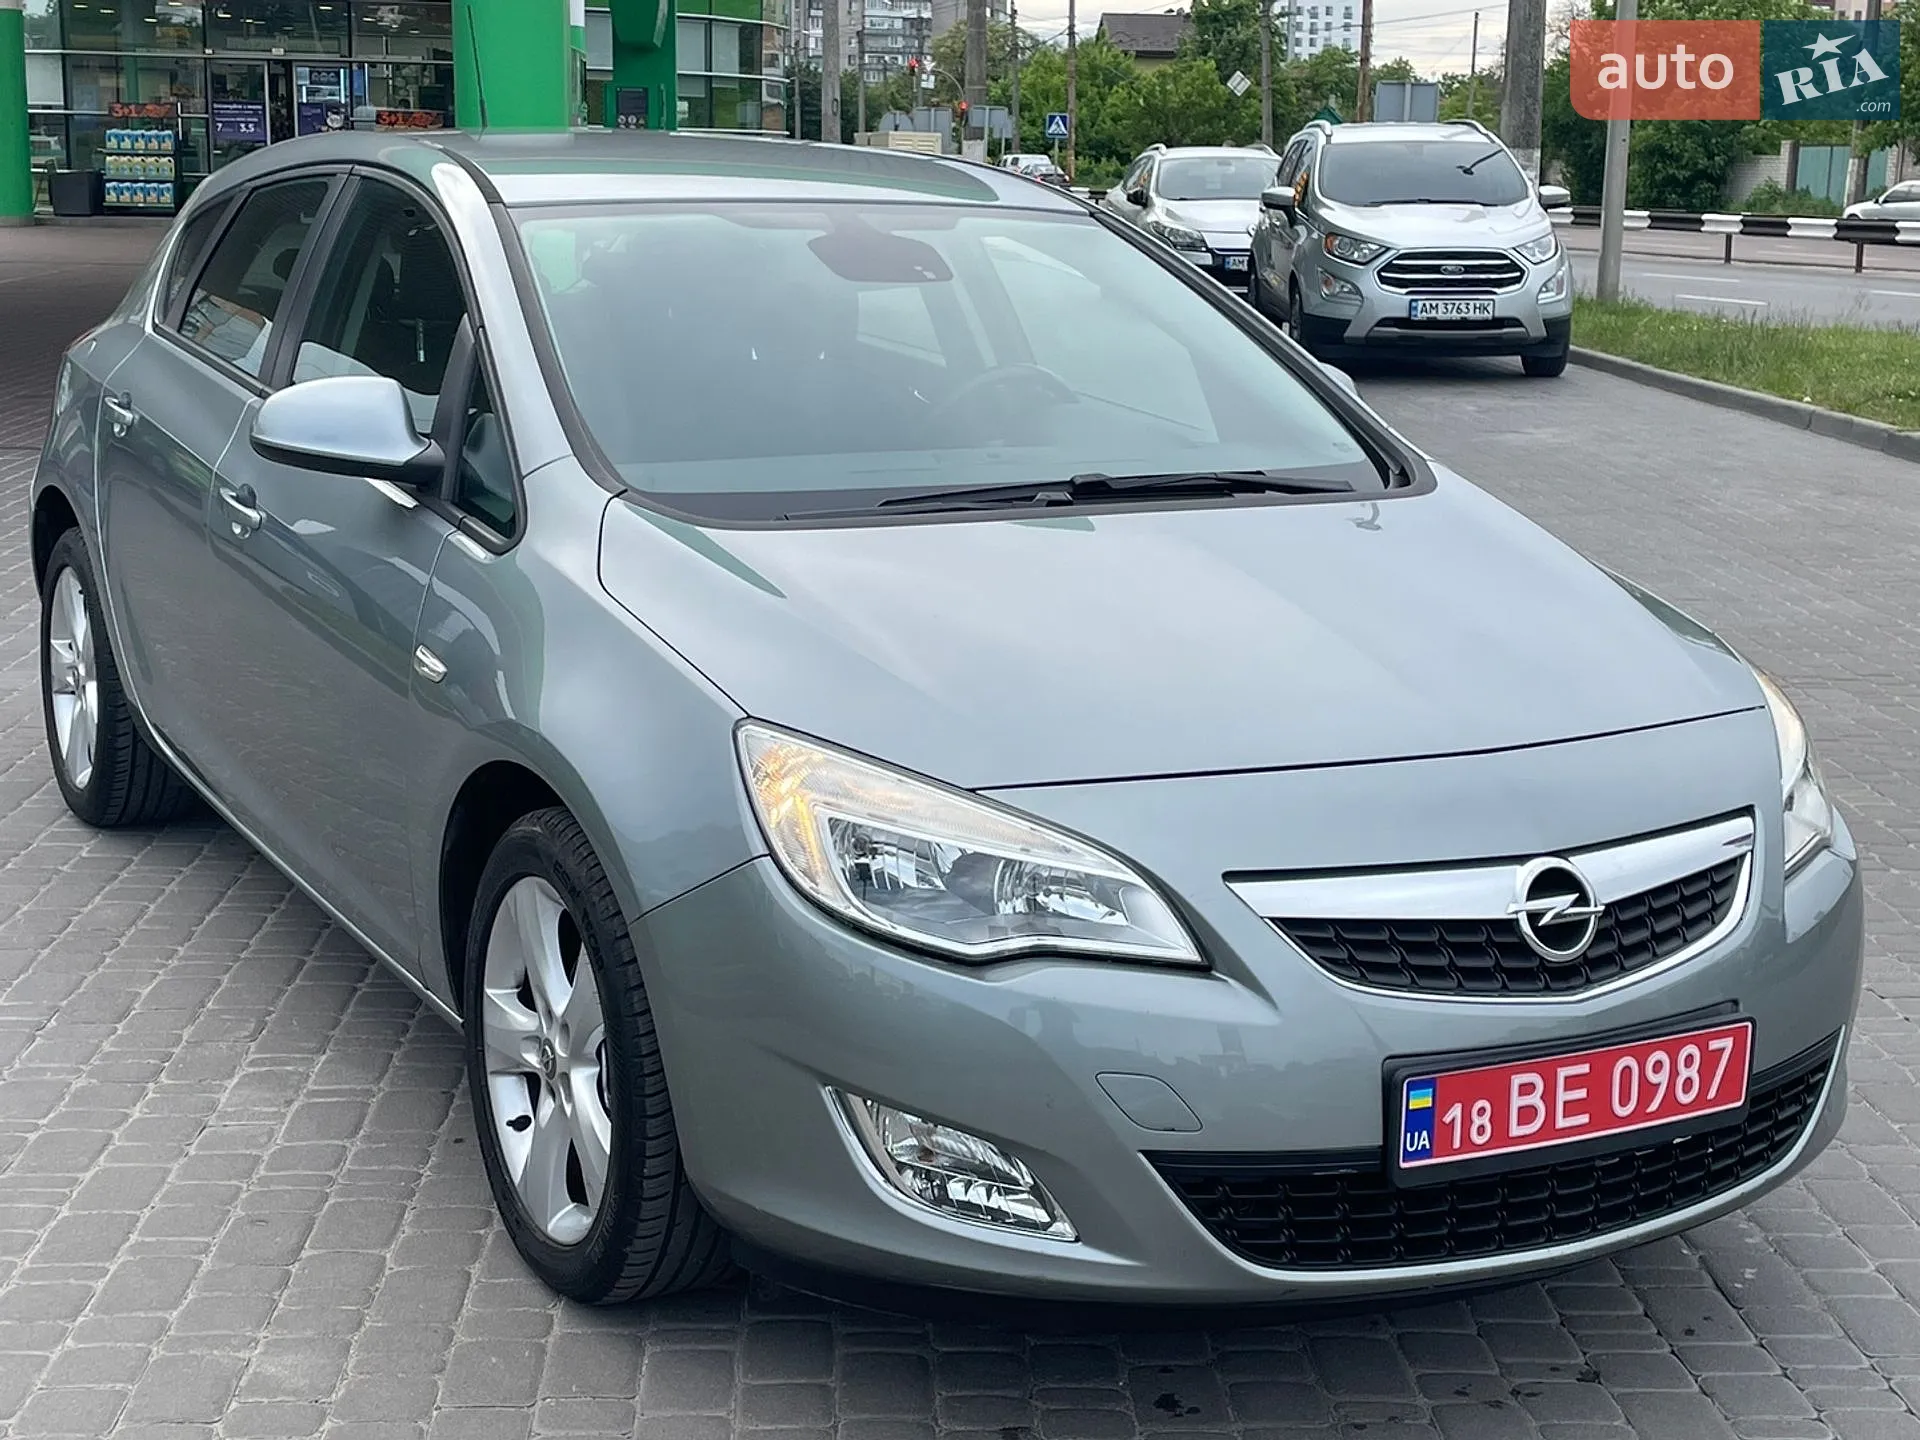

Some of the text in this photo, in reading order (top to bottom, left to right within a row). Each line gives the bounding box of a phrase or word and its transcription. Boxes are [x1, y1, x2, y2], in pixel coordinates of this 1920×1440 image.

[1231, 258, 1245, 267] AM
[1420, 302, 1491, 315] AM 3763 HK
[1441, 1036, 1735, 1150] 18 BE 0987
[1405, 1131, 1431, 1152] UA
